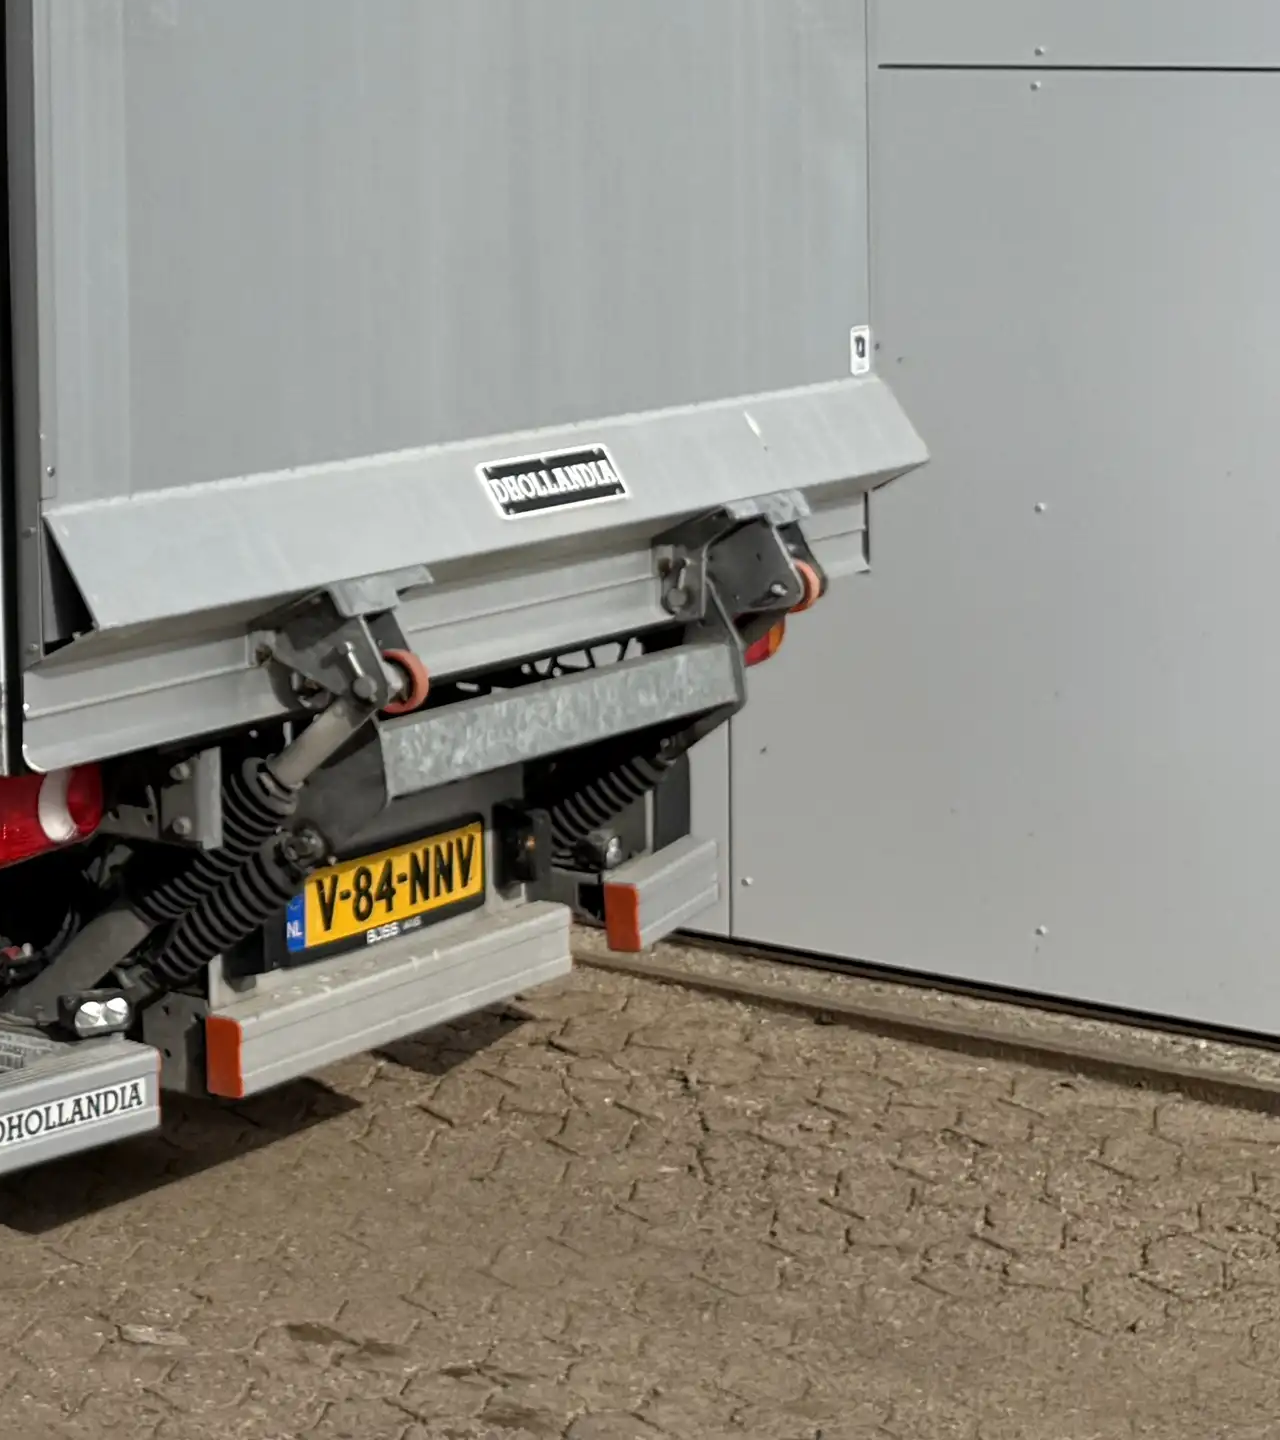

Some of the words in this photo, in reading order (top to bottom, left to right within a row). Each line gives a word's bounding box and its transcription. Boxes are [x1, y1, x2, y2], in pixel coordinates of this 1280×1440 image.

[488, 460, 619, 504] DHOLLANDIA
[315, 833, 475, 932] V-84-NNV
[286, 919, 304, 938] NL
